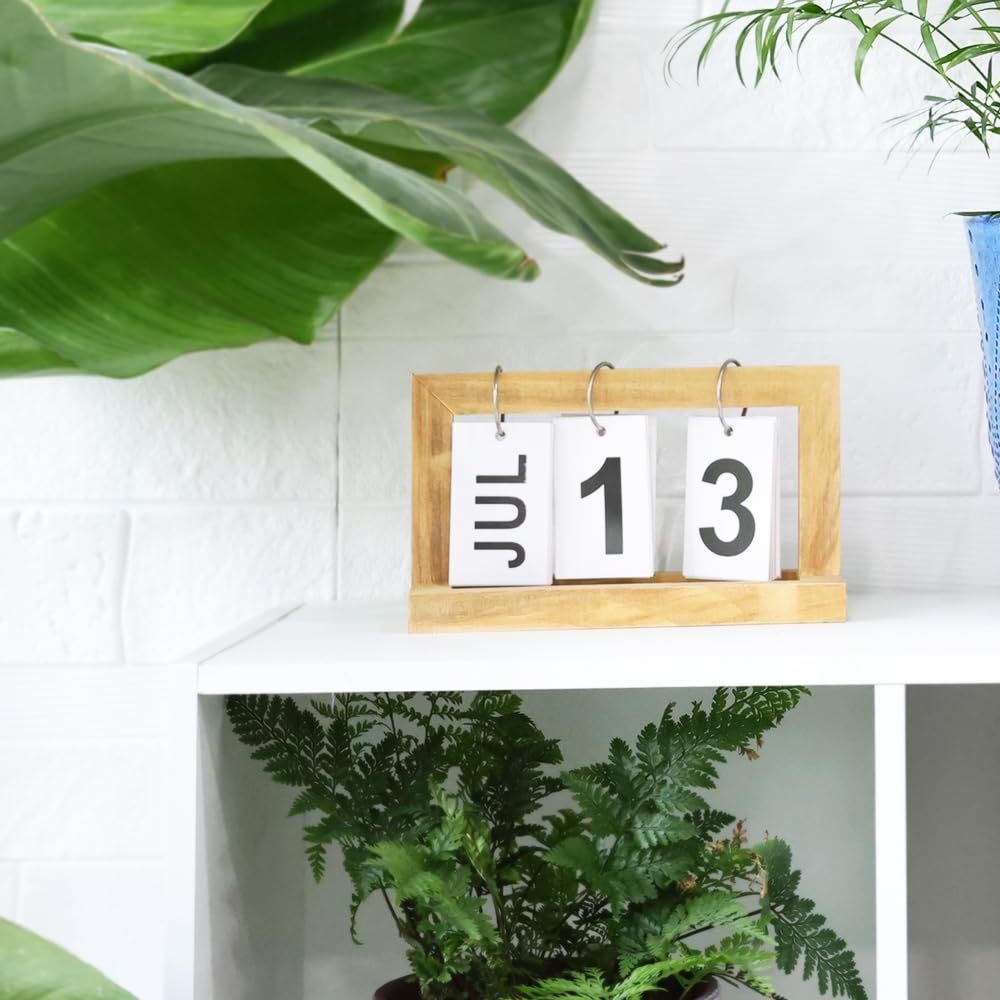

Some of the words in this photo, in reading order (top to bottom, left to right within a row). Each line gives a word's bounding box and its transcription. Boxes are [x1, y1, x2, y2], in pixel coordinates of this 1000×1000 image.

[473, 454, 527, 569] JUL
[580, 456, 624, 555] 1
[698, 457, 756, 557] 3
